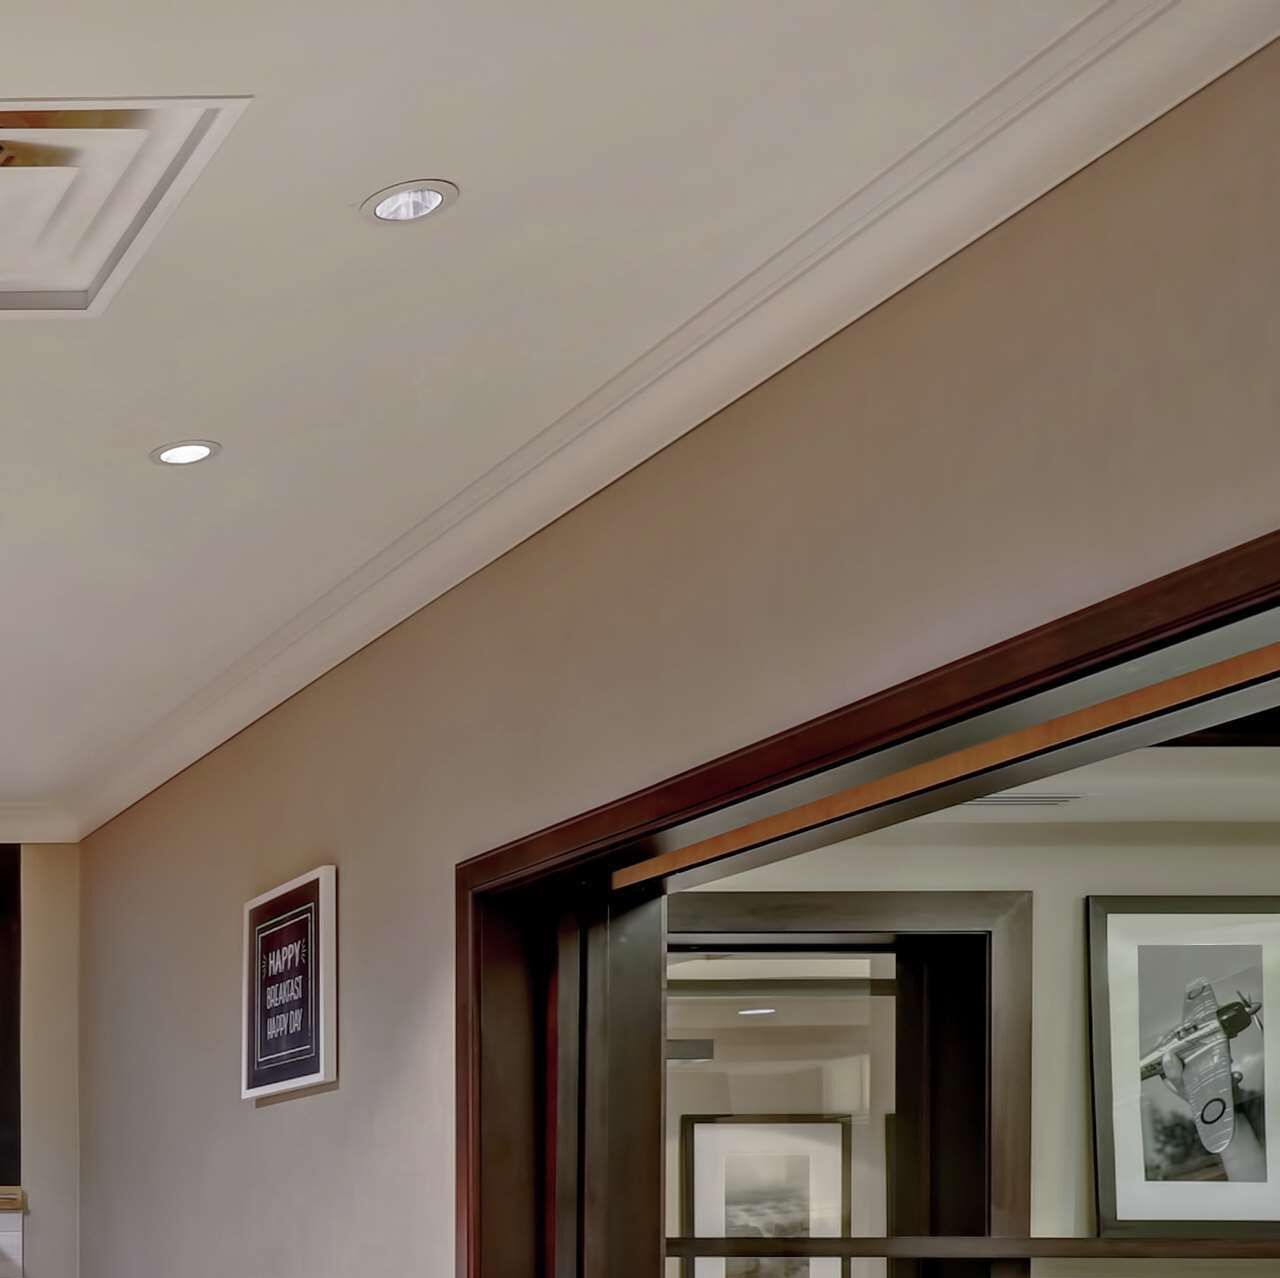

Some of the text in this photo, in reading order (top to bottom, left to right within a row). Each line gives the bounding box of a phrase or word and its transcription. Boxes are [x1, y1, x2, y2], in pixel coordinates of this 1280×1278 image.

[268, 940, 302, 976] HAPPY
[266, 975, 303, 1010] BREAKFAST
[267, 1008, 303, 1040] HAPPY DAY
